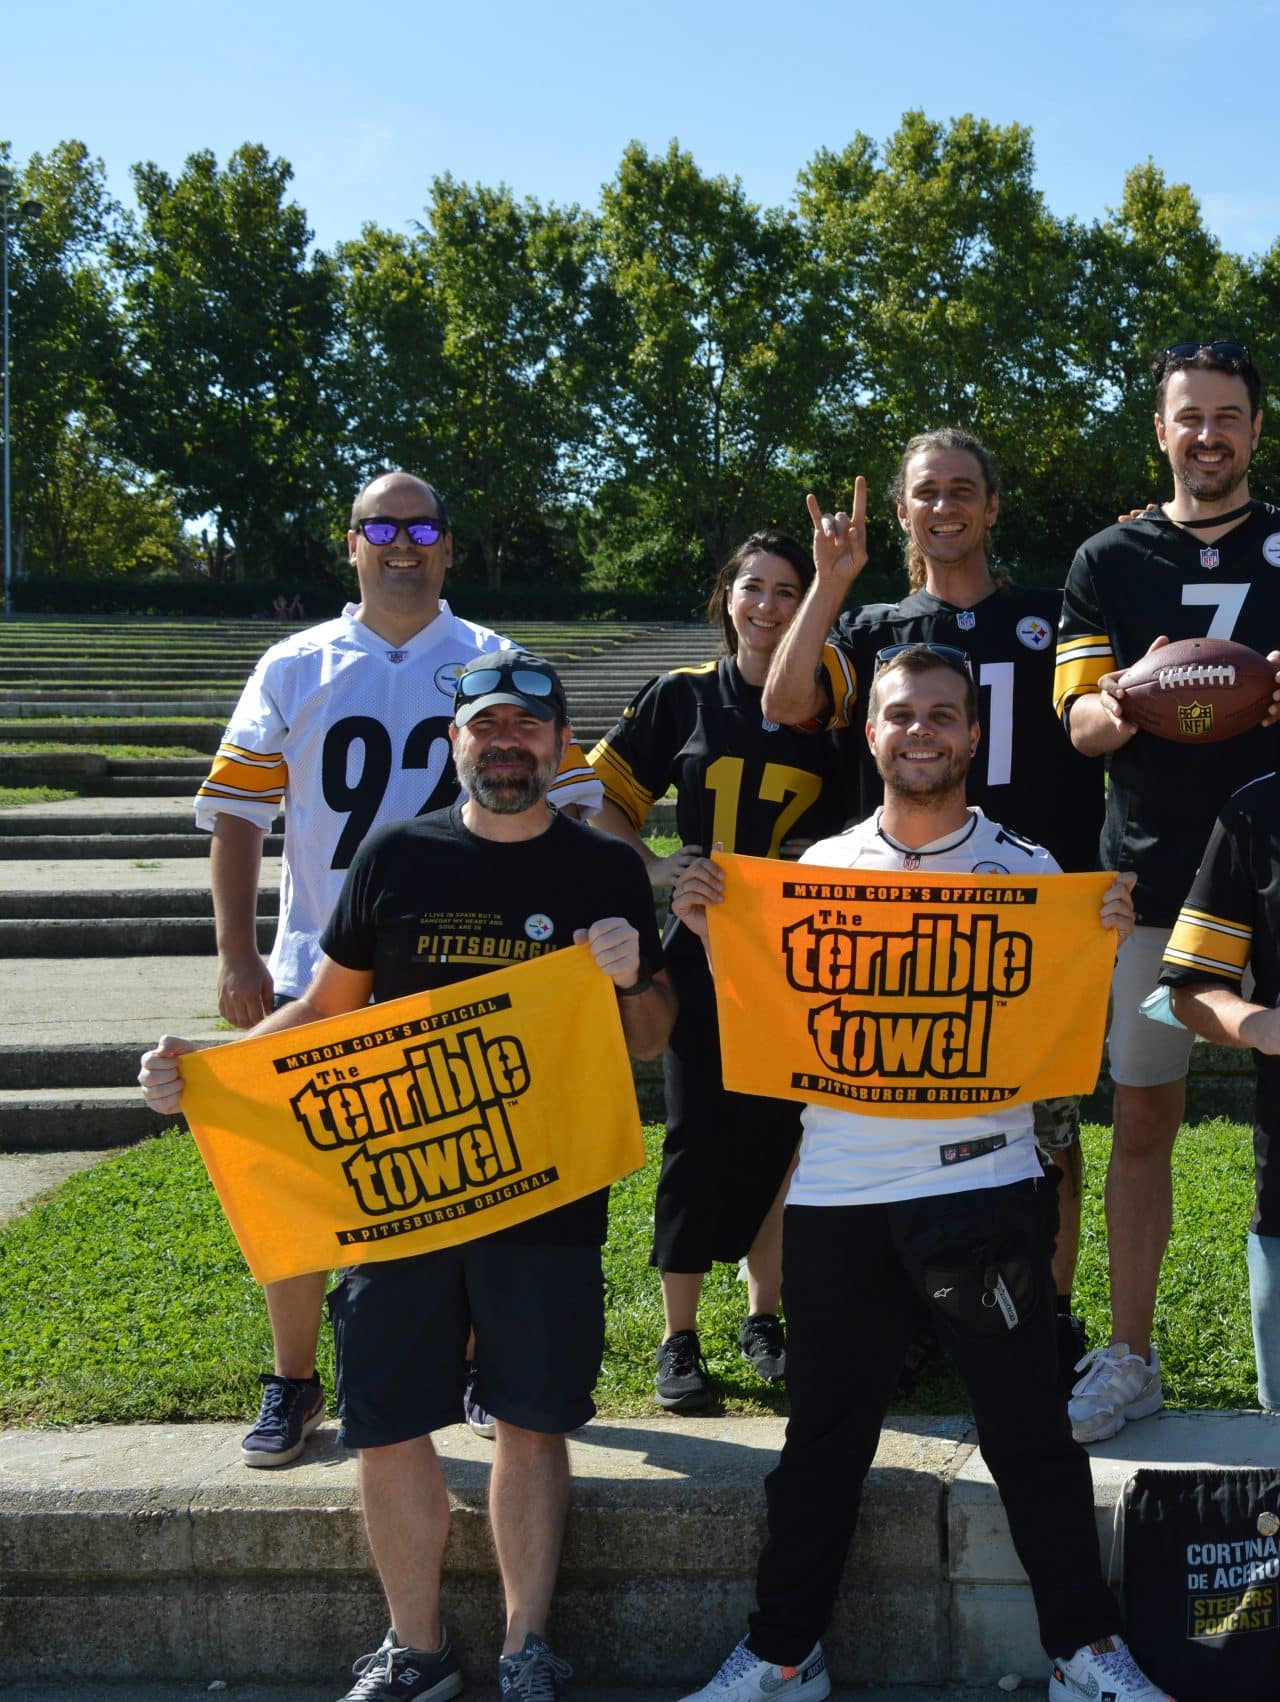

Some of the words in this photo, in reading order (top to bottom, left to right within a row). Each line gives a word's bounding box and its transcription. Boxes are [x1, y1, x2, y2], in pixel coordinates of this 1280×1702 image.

[1181, 582, 1251, 641] 7
[1182, 718, 1211, 734] NFL
[704, 756, 823, 860] 17
[794, 884, 856, 899] MYRON
[866, 887, 930, 901] COPE'S
[941, 888, 1025, 903] OFFICIAL
[819, 910, 862, 926] The
[782, 912, 1032, 997] terrible
[286, 1042, 345, 1069] MYRON
[353, 1023, 412, 1053] COPE'S
[421, 999, 497, 1032] OFFICIAL
[808, 995, 993, 1079] towel
[289, 1026, 531, 1151] terrible
[316, 1064, 360, 1085] The
[800, 1076, 809, 1088] A
[817, 1078, 917, 1101] PITTSBURGH
[927, 1088, 1014, 1101] ORIGINAL
[341, 1104, 521, 1216] towel
[346, 1231, 357, 1244] A
[362, 1206, 467, 1242] PITTSBURGH
[475, 1173, 550, 1209] ORIGINAL
[1186, 1536, 1278, 1566] CORTINA
[1188, 1573, 1208, 1590] DE
[1213, 1557, 1280, 1589] ACERO
[1194, 1588, 1273, 1617] STEELERS
[1194, 1608, 1272, 1637] PODCAST
